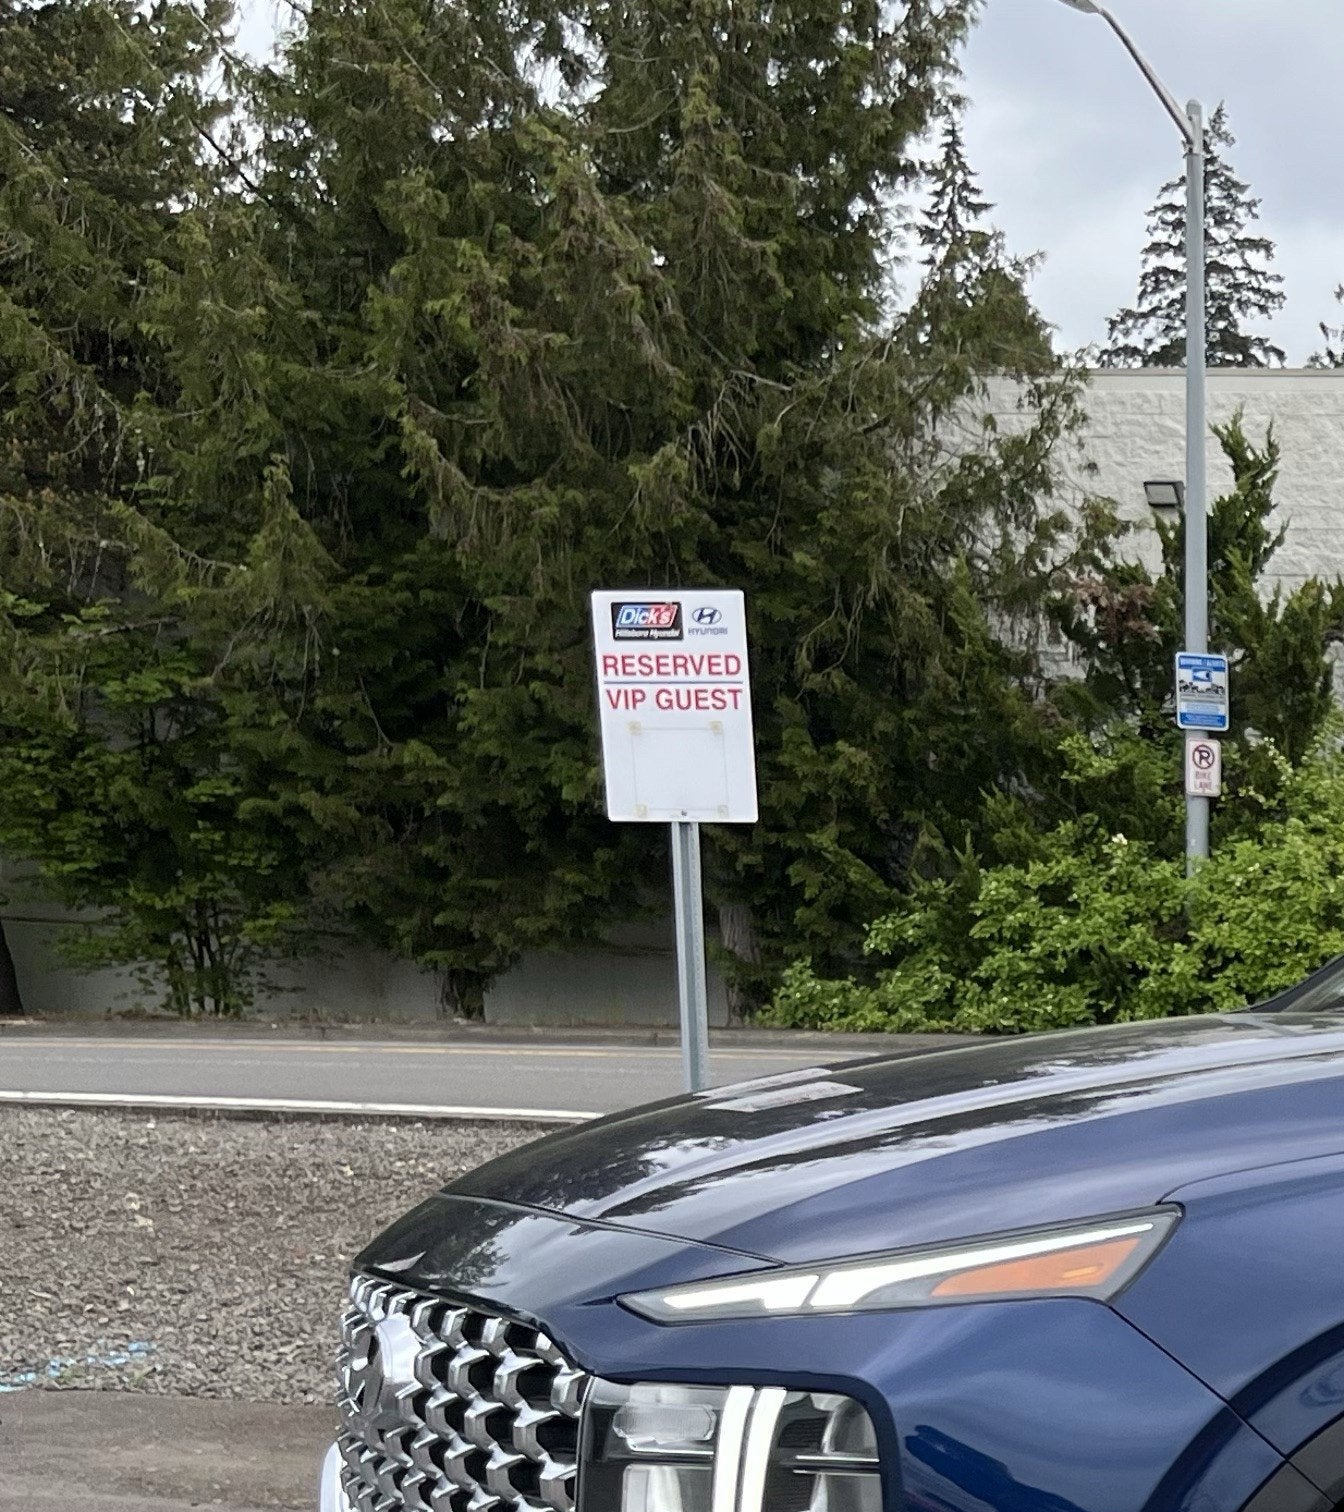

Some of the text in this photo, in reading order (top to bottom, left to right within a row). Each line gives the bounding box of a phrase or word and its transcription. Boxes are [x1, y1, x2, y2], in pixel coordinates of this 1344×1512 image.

[603, 654, 741, 676] RESERVED
[607, 688, 743, 710] VIP GUEST
